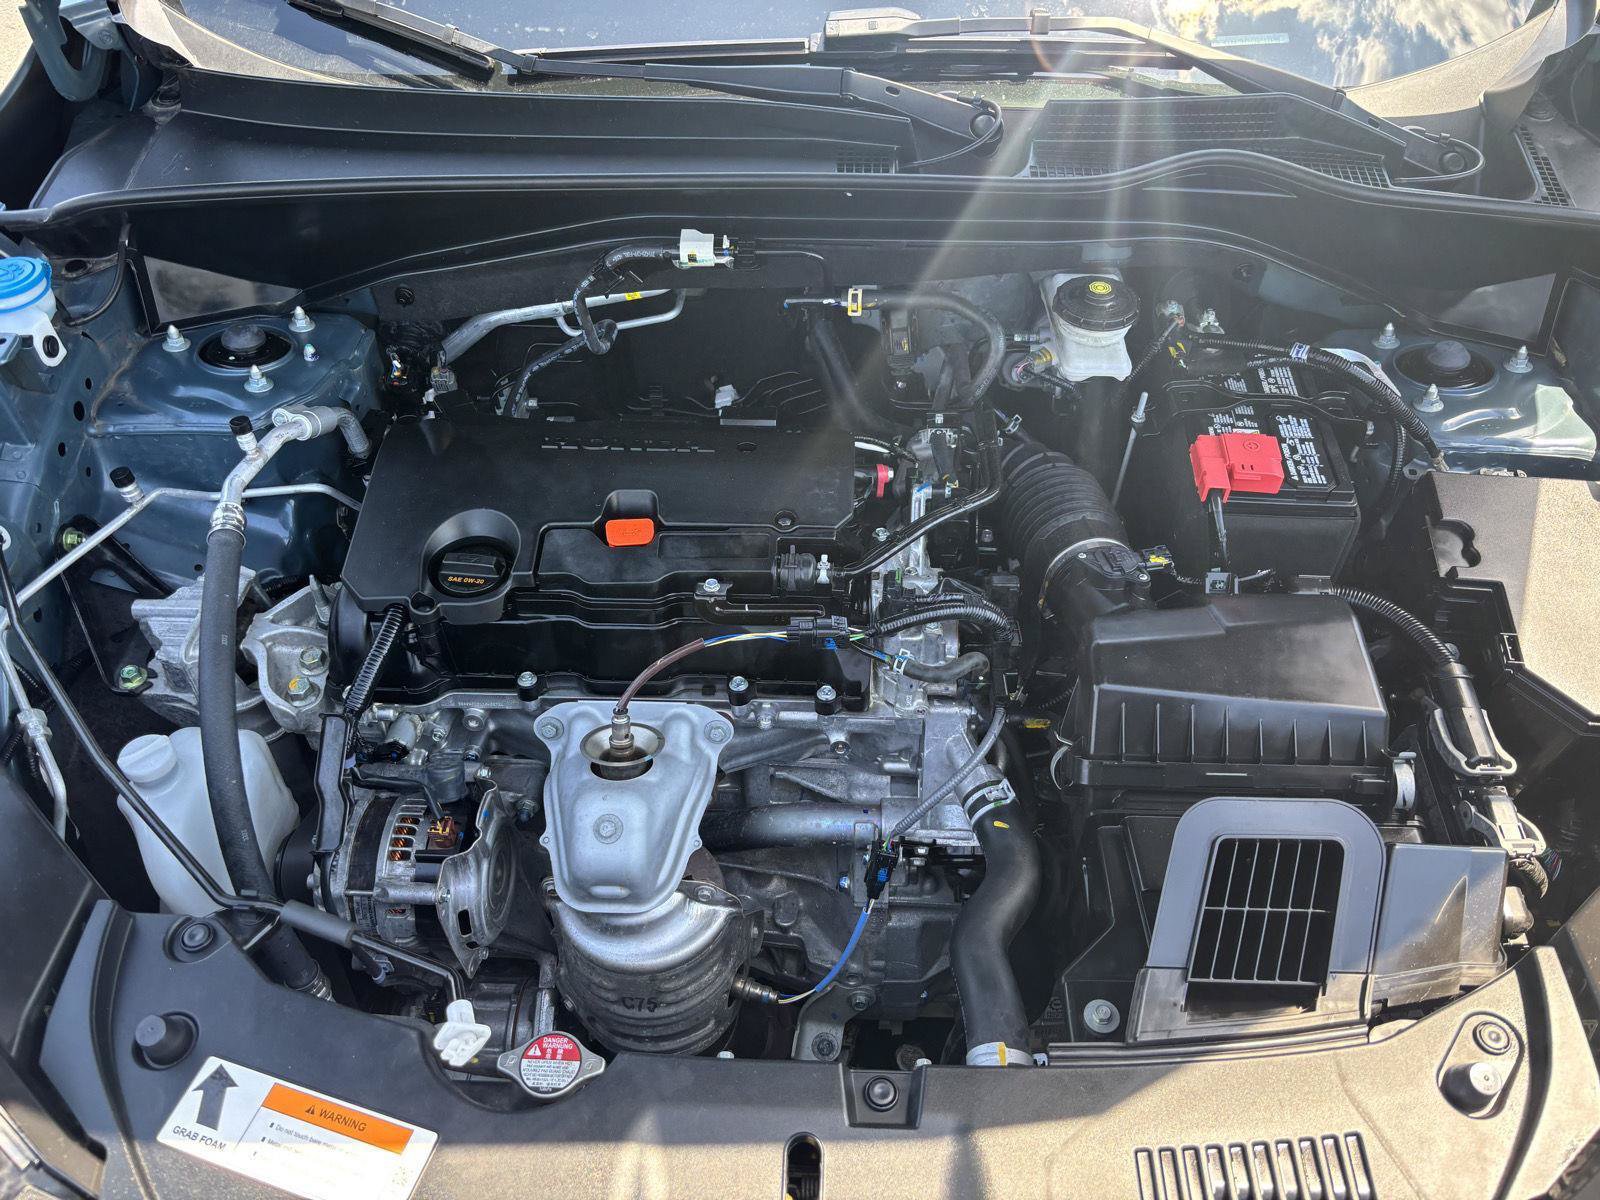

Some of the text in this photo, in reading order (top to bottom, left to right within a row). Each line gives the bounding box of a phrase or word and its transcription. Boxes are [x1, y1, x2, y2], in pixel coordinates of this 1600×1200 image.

[622, 997, 658, 1012] C75
[319, 1108, 367, 1132] WARNING
[172, 1125, 227, 1151] GRAB FOAM
[286, 1126, 294, 1136] not
